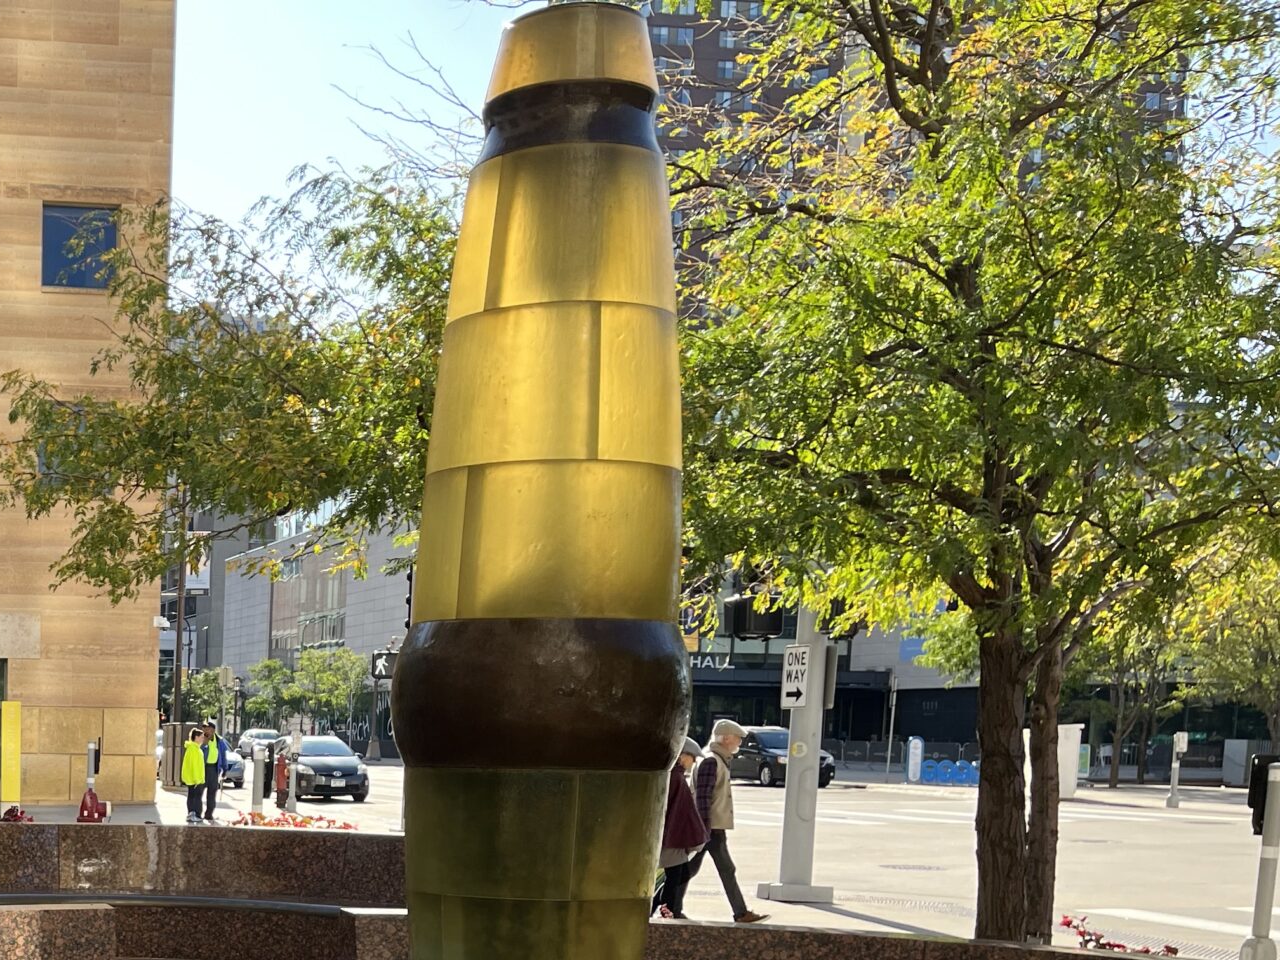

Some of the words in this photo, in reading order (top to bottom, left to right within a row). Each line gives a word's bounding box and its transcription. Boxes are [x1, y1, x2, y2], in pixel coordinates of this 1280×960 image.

[690, 655, 735, 669] HALL
[787, 651, 807, 666] ONE
[786, 669, 806, 683] WAY
